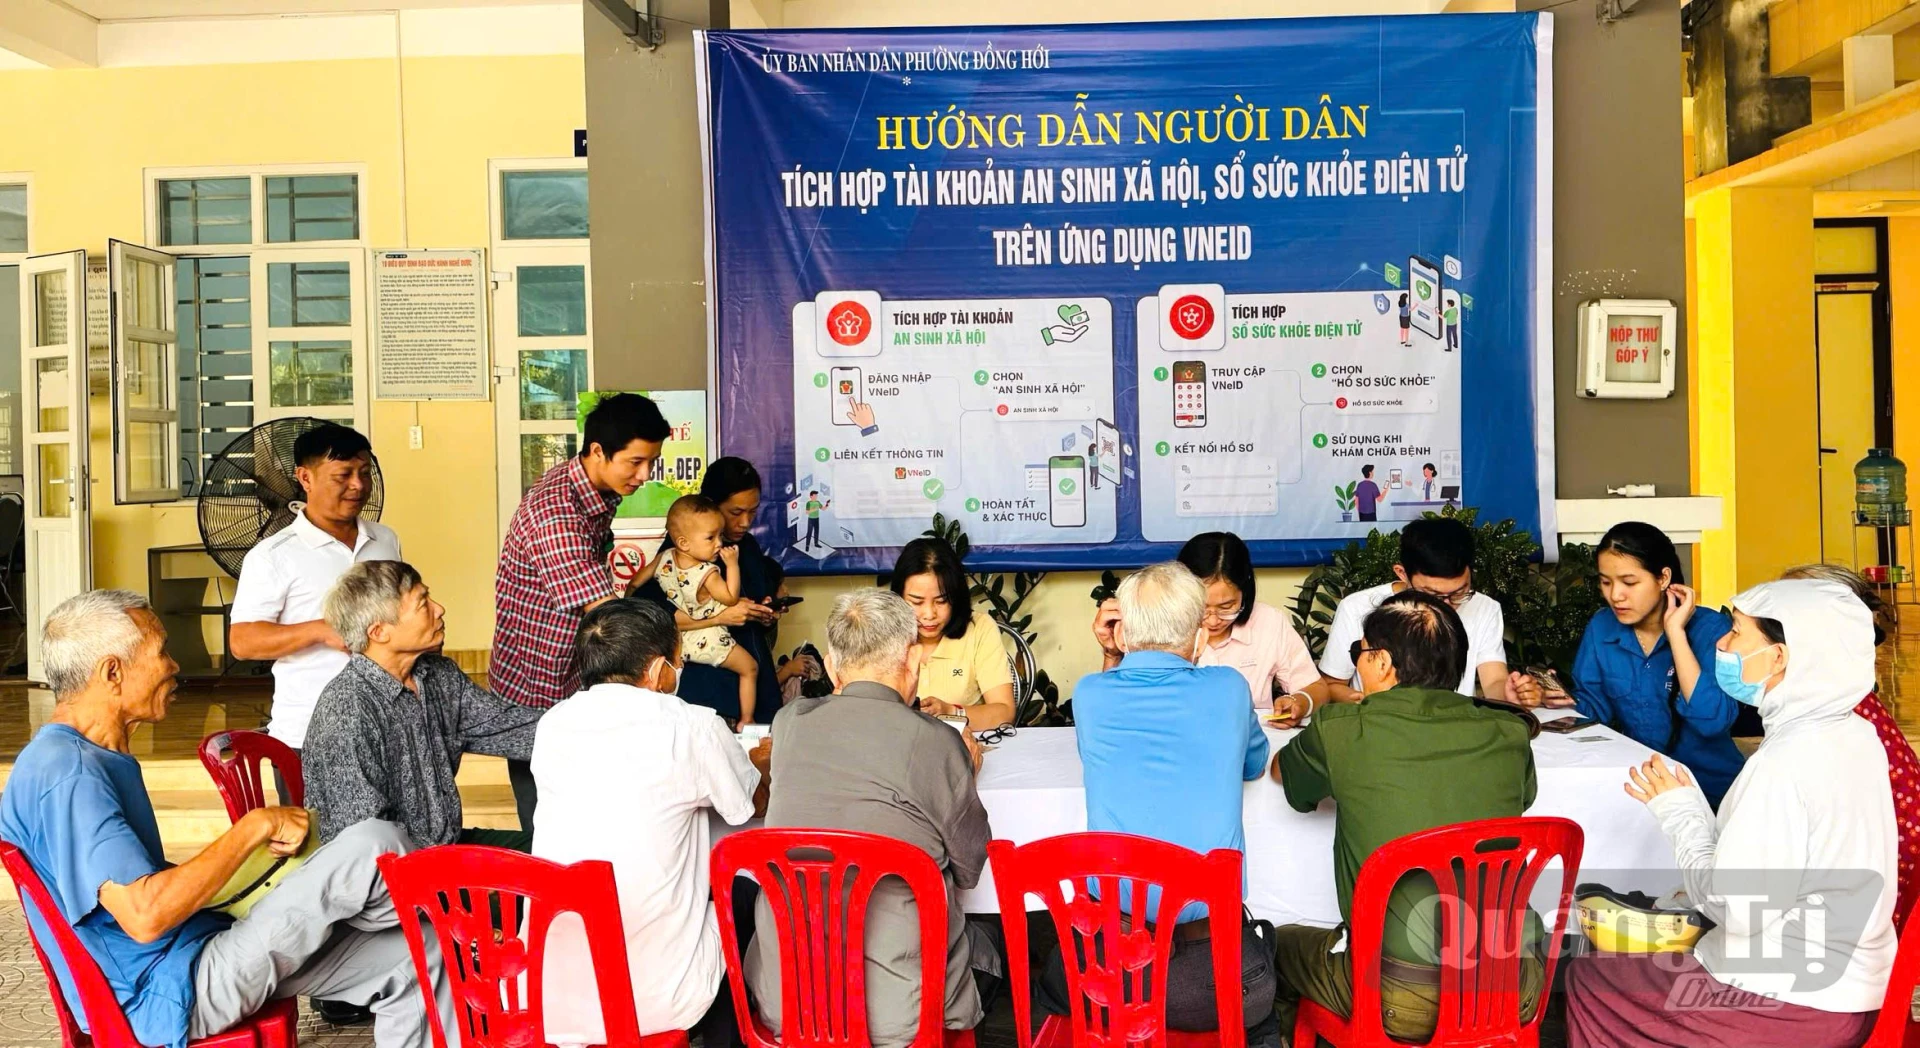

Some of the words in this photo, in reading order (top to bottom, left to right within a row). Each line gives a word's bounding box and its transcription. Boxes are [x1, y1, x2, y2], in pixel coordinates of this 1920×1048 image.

[762, 46, 784, 73] ỦY
[787, 53, 819, 73] BAN
[822, 46, 866, 73] NHÂN
[869, 45, 901, 72] DÂN
[904, 45, 970, 71] PHƯỜNG
[972, 40, 1018, 70] ĐỒNG
[1021, 43, 1051, 69] HỚI
[876, 104, 1026, 150] HƯỚNG
[1037, 92, 1123, 147] DẪN
[1134, 94, 1271, 144] NGƯỜI
[1282, 94, 1370, 141] DÂN
[781, 164, 833, 208] TÍCH
[841, 167, 887, 215] HỢP
[893, 163, 929, 207] TÀI
[936, 158, 1015, 206] KHOẢN
[1022, 169, 1054, 205] AN
[1061, 168, 1116, 203] SINH
[1123, 160, 1155, 202] XÃ
[1161, 157, 1207, 208] HỘI,
[1214, 149, 1246, 200] SỔ
[1252, 154, 1299, 199] SỨC
[1306, 149, 1367, 197] KHỎE
[1374, 152, 1430, 202] ĐIỆN
[1436, 144, 1468, 193] TỬ
[993, 223, 1052, 267] TRÊN
[1058, 222, 1106, 264] ỨNG
[1113, 226, 1177, 271] DỤNG
[1183, 225, 1252, 262] VNEID
[893, 310, 920, 326] TÍCH
[923, 311, 947, 328] HỢP
[951, 309, 969, 325] TÀI
[972, 307, 1014, 324] KHOẢN
[1231, 304, 1259, 320] TÍCH
[1262, 304, 1287, 321] HỢP
[1252, 322, 1276, 339] SỨC
[1280, 320, 1311, 338] KHỎE
[1314, 321, 1343, 340] ĐIỆN
[1347, 318, 1363, 337] TỬ
[1610, 324, 1633, 346] HỘP
[1636, 325, 1660, 342] THƯ
[893, 332, 910, 345] AN
[914, 331, 943, 345] SINH
[946, 329, 963, 345] XÃ
[966, 328, 986, 347] HỘI
[1615, 346, 1639, 363] GÓP
[1642, 346, 1649, 363] Ý
[992, 372, 1024, 383] CHỌN
[1211, 368, 1241, 377] TRUY
[1243, 365, 1266, 378] CẬP
[1316, 366, 1323, 376] 2
[1331, 365, 1363, 376] CHỌN
[868, 373, 899, 384] ĐĂNG
[902, 371, 932, 385] NHẬP
[1355, 376, 1372, 387] SƠ
[1373, 375, 1397, 387] SỨC
[868, 387, 900, 397] VNeID
[1016, 384, 1041, 394] SINH
[1044, 383, 1059, 394] XÃ
[1211, 380, 1244, 391] VNeID
[1316, 436, 1324, 446] 4
[1331, 432, 1347, 445] SỬ
[1349, 435, 1381, 446] DỤNG
[1384, 434, 1402, 444] KHI
[834, 448, 859, 460] LIÊN
[861, 447, 883, 460] KẾT
[885, 448, 924, 460] THÔNG
[926, 449, 944, 459] TIN
[1174, 441, 1196, 454] KẾT
[1199, 441, 1217, 453] NỐI
[1238, 442, 1254, 453] SƠ
[1332, 446, 1364, 457] KHÁM
[1366, 445, 1397, 457] CHỮA
[1400, 445, 1431, 457] BỆNH
[676, 457, 702, 486] ĐẸP
[907, 469, 931, 477] VNeID
[982, 498, 1012, 510] HOÀN
[1014, 496, 1036, 509] TẤT
[982, 513, 990, 522] &
[992, 511, 1015, 522] XÁC
[1018, 511, 1047, 523] THỰC
